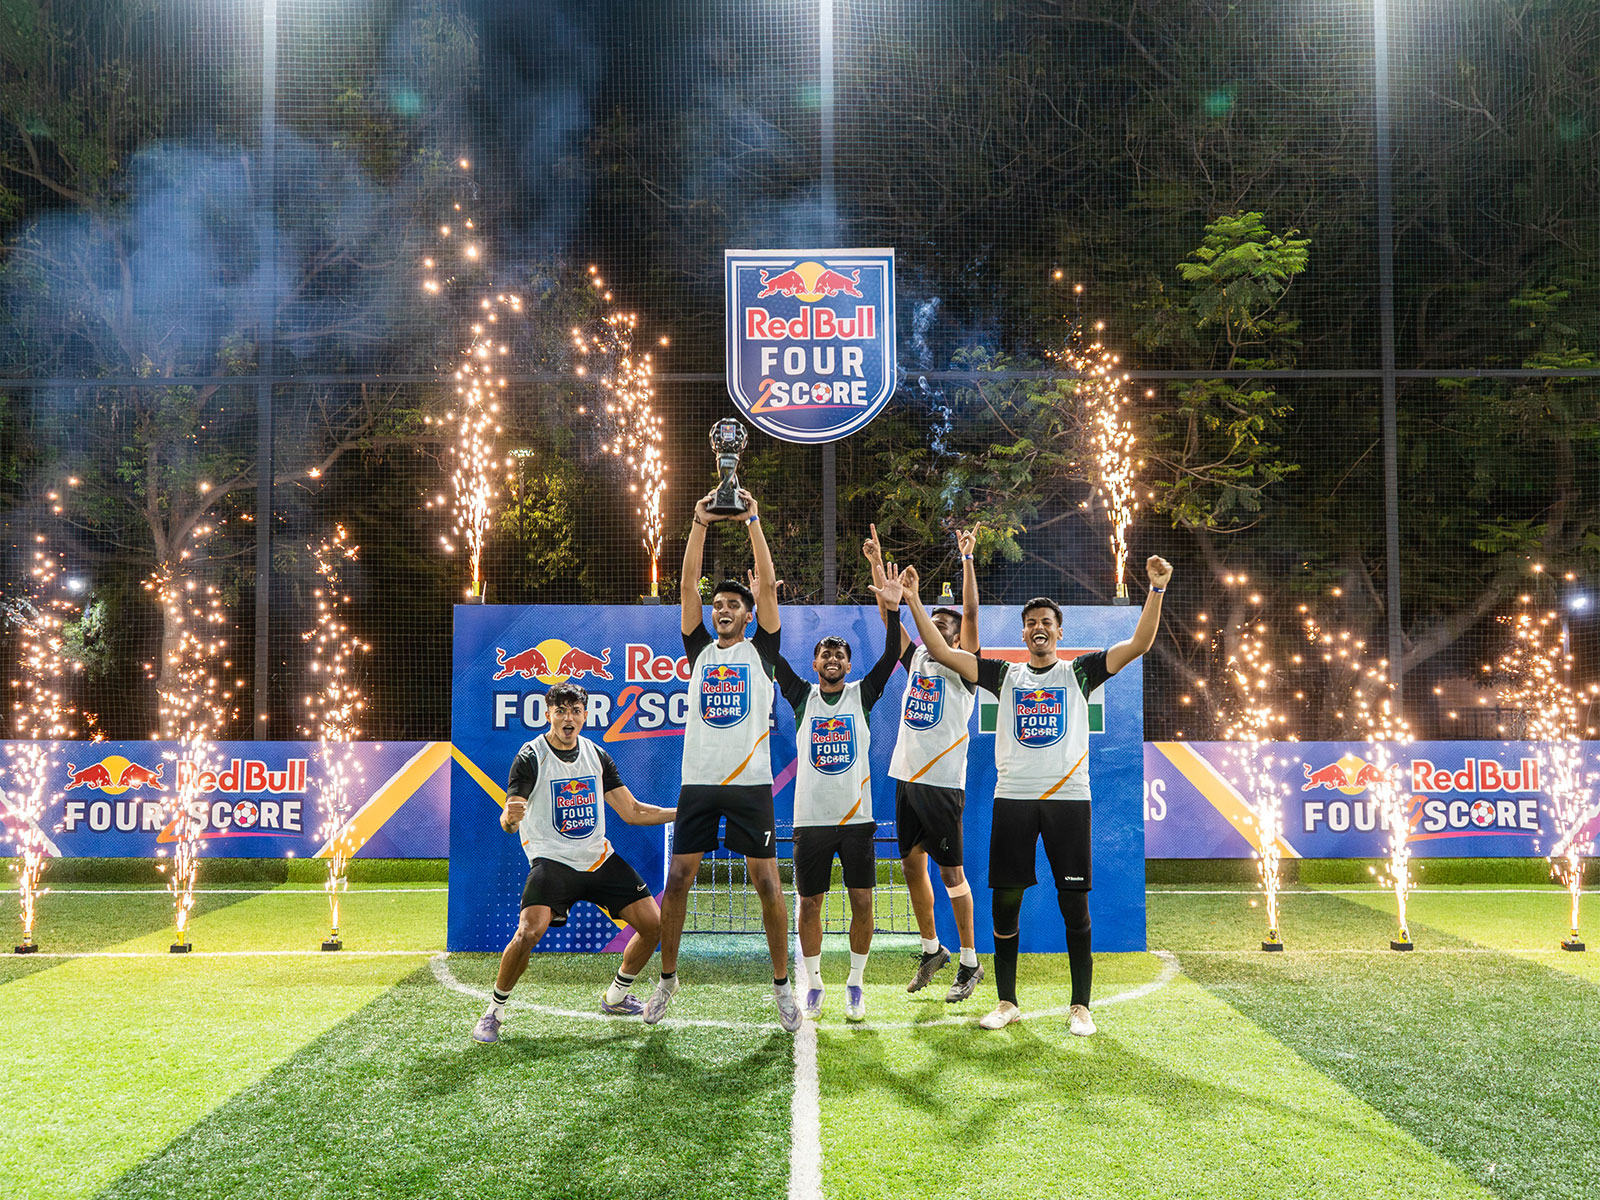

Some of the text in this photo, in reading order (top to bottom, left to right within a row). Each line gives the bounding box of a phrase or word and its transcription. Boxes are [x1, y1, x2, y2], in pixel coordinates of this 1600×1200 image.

[746, 305, 875, 340] Red Bull
[761, 347, 864, 378] FOUR
[703, 681, 745, 694] Red Bull
[707, 695, 741, 706] FOUR
[908, 700, 934, 714] FOUR
[495, 693, 611, 727] FOR
[1017, 703, 1061, 716] Red Bull
[1021, 716, 1057, 727] FOUR
[812, 730, 851, 744] Red Bull
[817, 744, 849, 755] FOUR
[243, 758, 308, 793] Bull
[1411, 757, 1542, 793] Red Bull
[557, 792, 596, 808] Red Bull
[66, 801, 163, 831] FOUR
[562, 807, 594, 819] FOUR
[764, 830, 771, 847] 7
